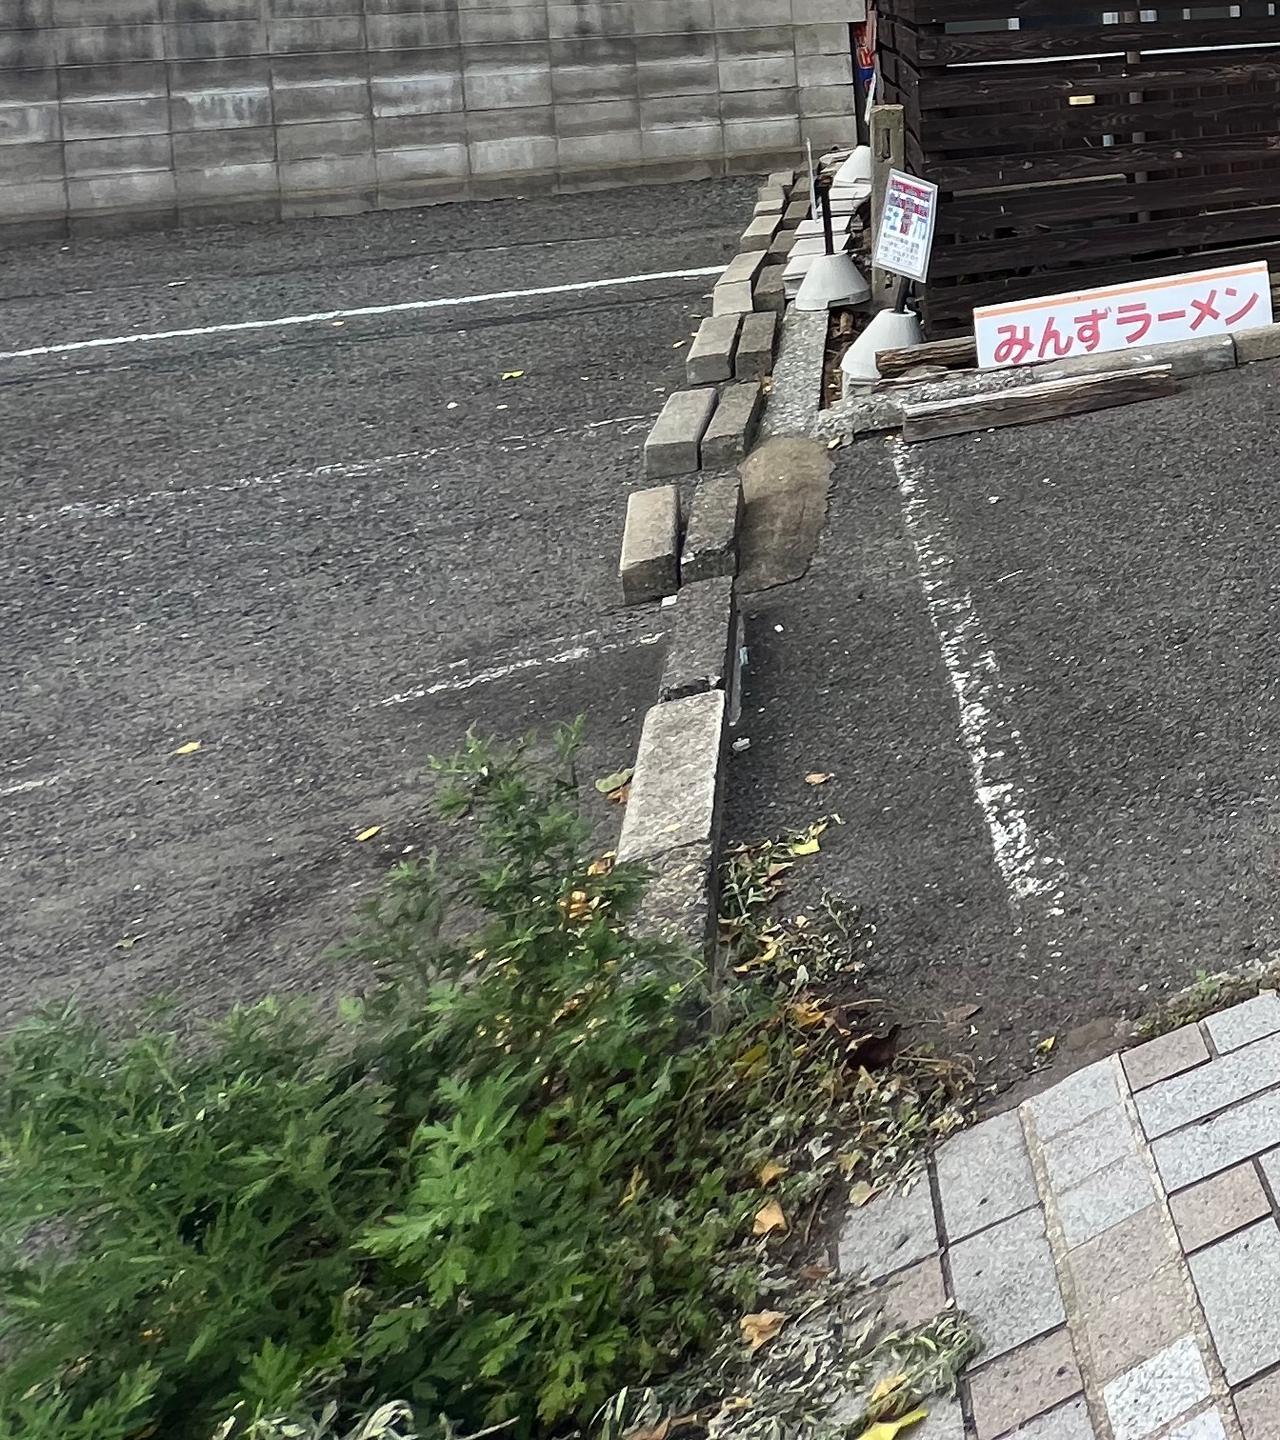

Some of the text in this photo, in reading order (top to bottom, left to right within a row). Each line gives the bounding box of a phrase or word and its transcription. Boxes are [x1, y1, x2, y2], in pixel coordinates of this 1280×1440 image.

[993, 287, 1260, 363] みんずラーメン
